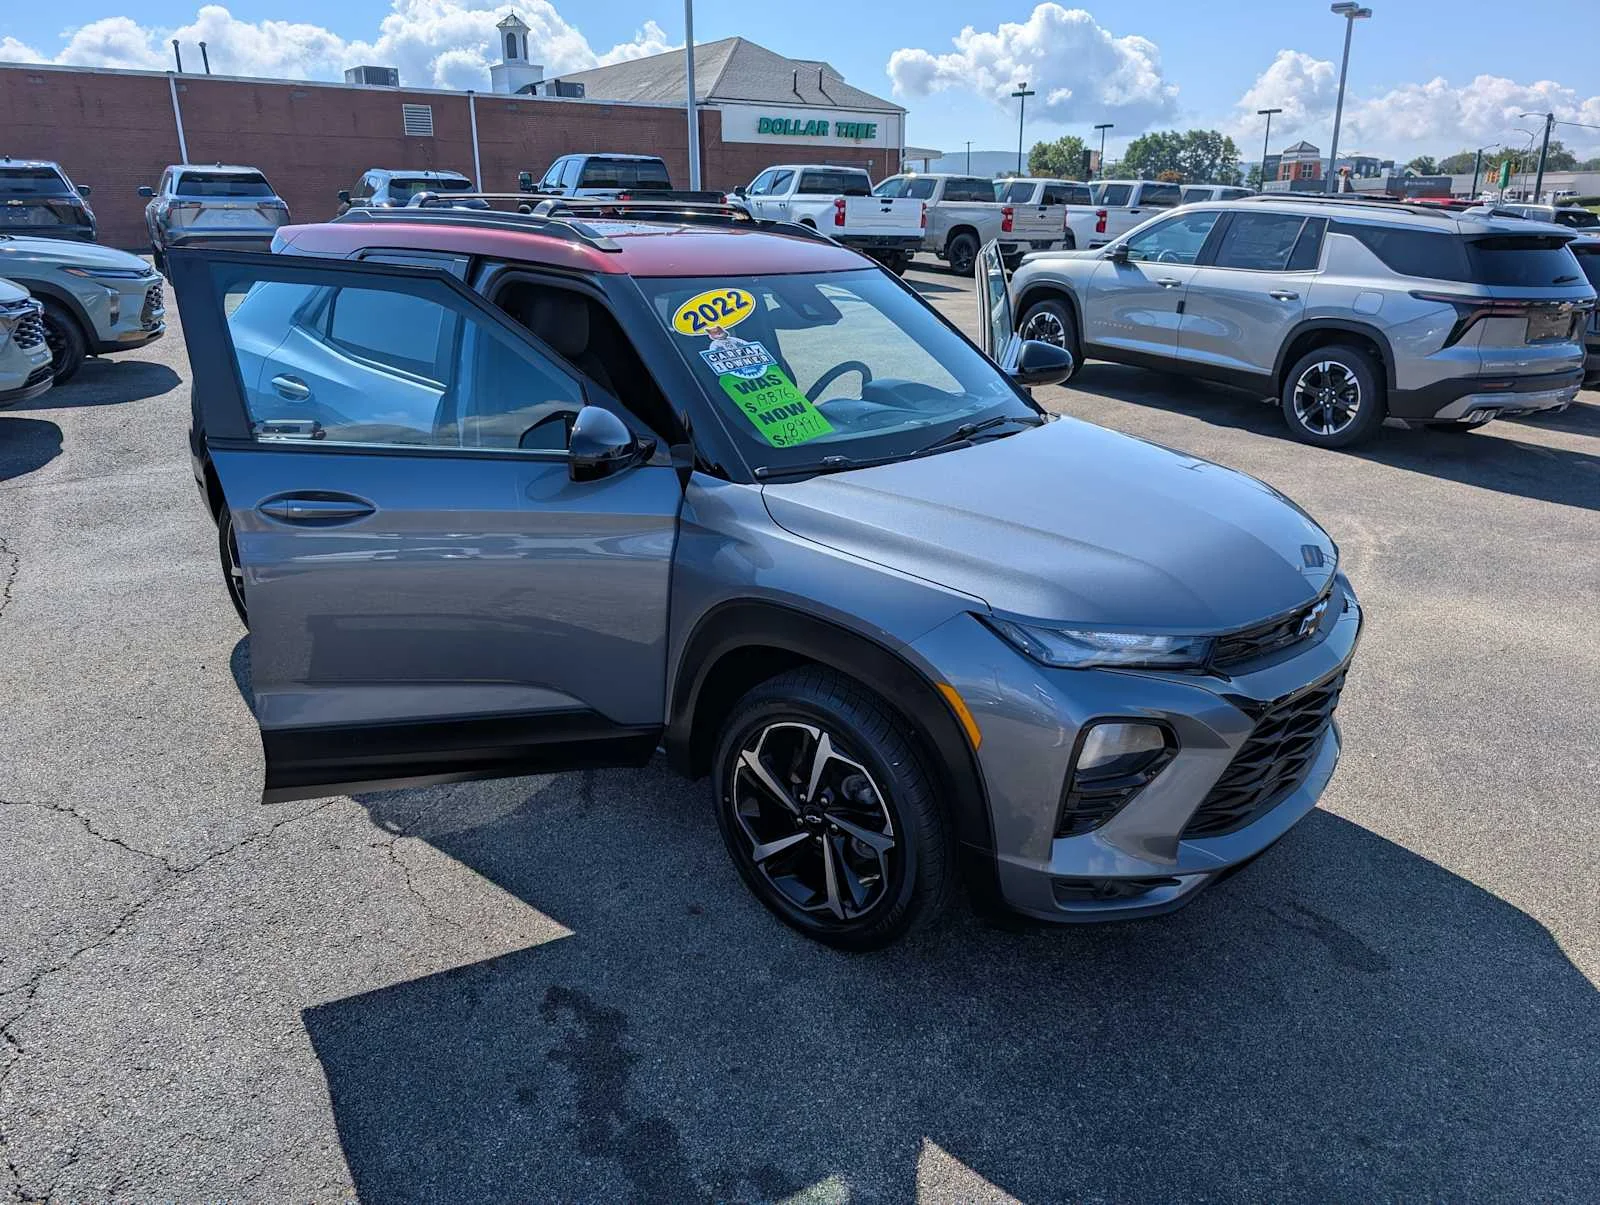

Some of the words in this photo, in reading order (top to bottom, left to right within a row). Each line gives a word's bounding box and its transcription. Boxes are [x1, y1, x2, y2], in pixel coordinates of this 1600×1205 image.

[758, 117, 829, 137] DOLLAR
[835, 121, 877, 139] TREE
[683, 291, 749, 332] 2022
[708, 346, 762, 362] CARFAX
[733, 374, 783, 395] WAS
[758, 401, 807, 425] NOW
